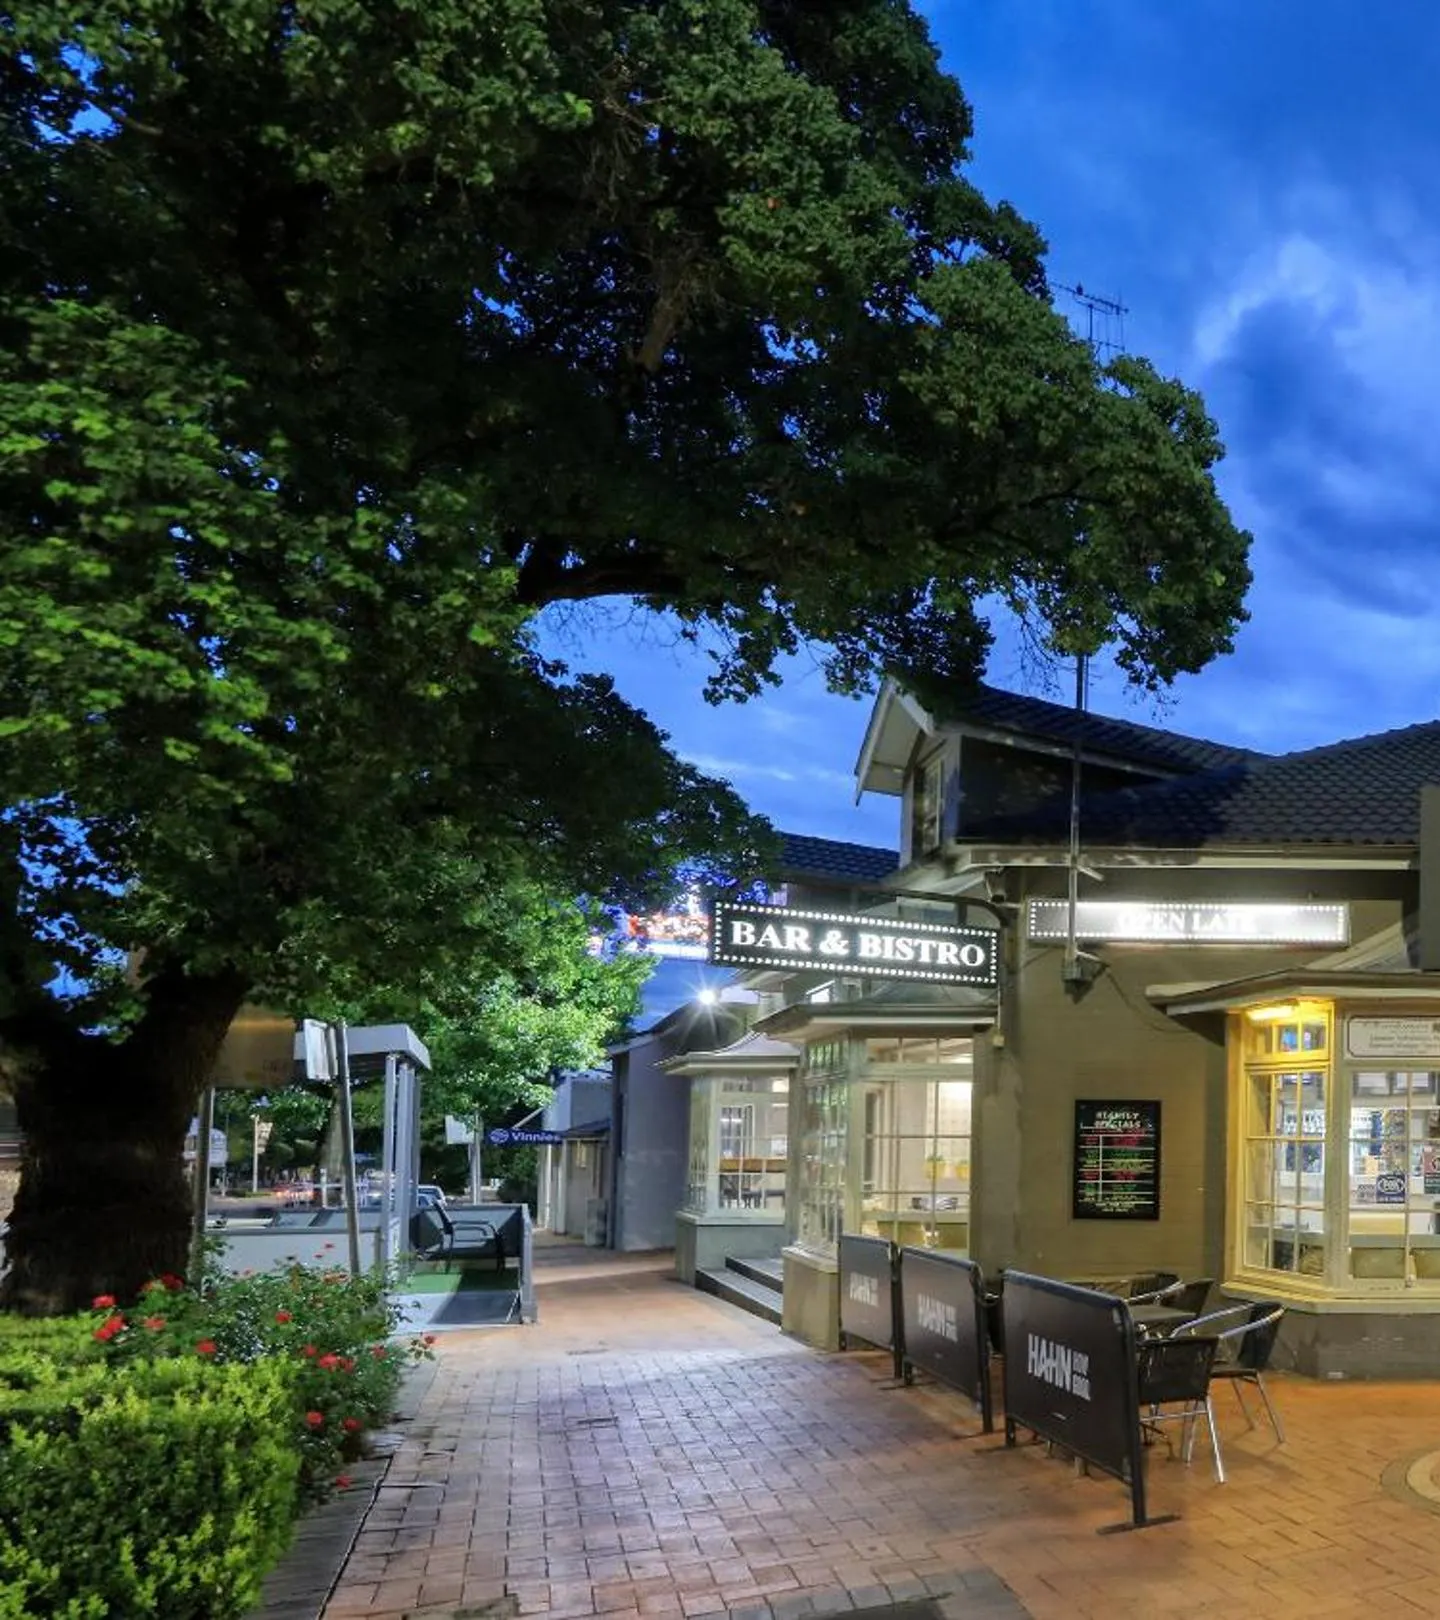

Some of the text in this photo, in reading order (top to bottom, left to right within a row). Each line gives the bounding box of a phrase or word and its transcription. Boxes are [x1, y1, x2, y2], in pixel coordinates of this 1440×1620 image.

[732, 920, 986, 968] BAR & BISTRO
[511, 1130, 562, 1141] Vinnies
[1028, 1333, 1072, 1392] HAHN
